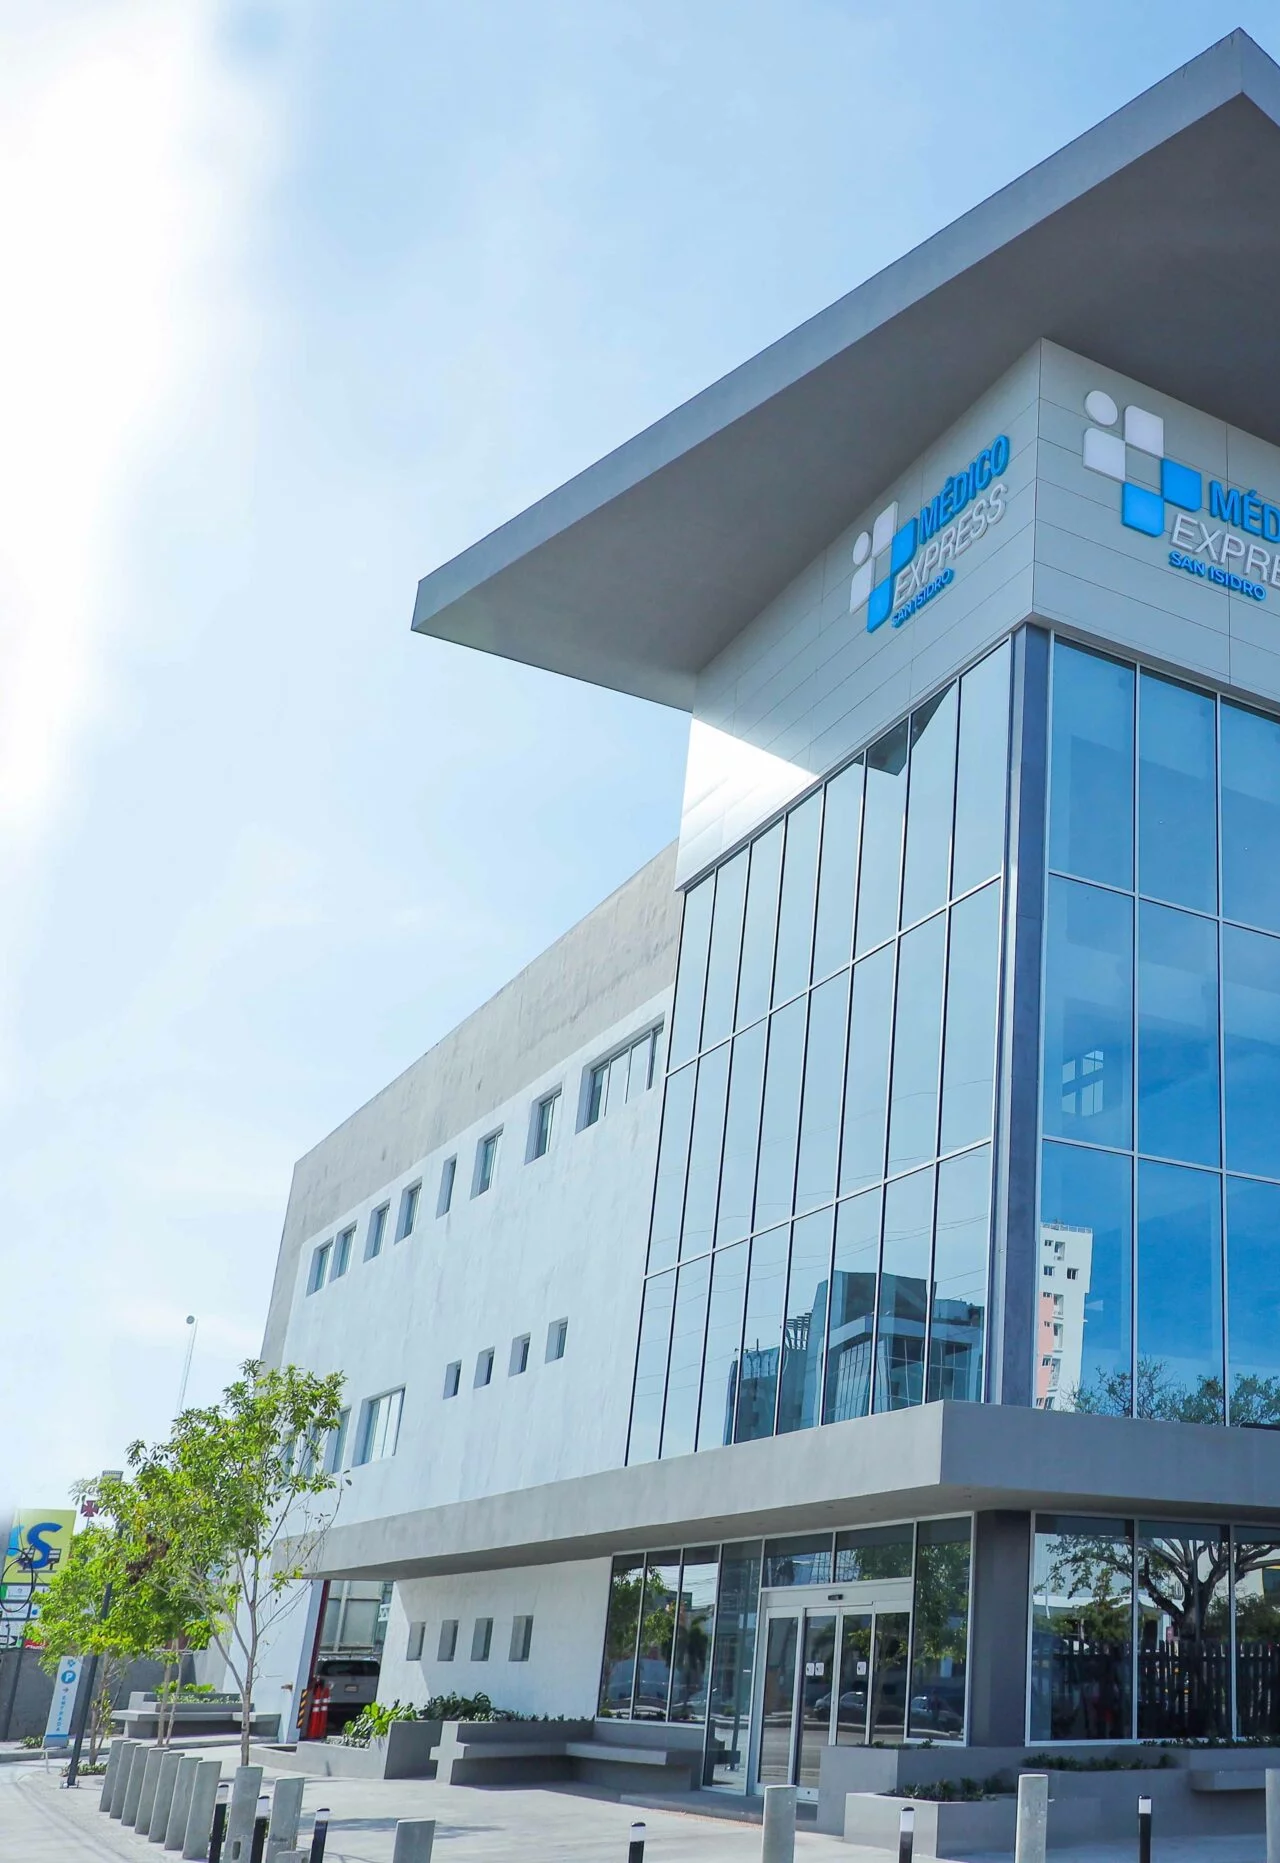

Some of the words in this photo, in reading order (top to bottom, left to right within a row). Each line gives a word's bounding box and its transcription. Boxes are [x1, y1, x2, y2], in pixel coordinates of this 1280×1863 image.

[918, 434, 1010, 545] MÉDICO
[892, 483, 1008, 609] EXPRESS
[1168, 550, 1206, 577] SAN
[1208, 565, 1267, 601] ISIDRO
[891, 600, 915, 628] SAN
[914, 568, 954, 609] ISIDRO
